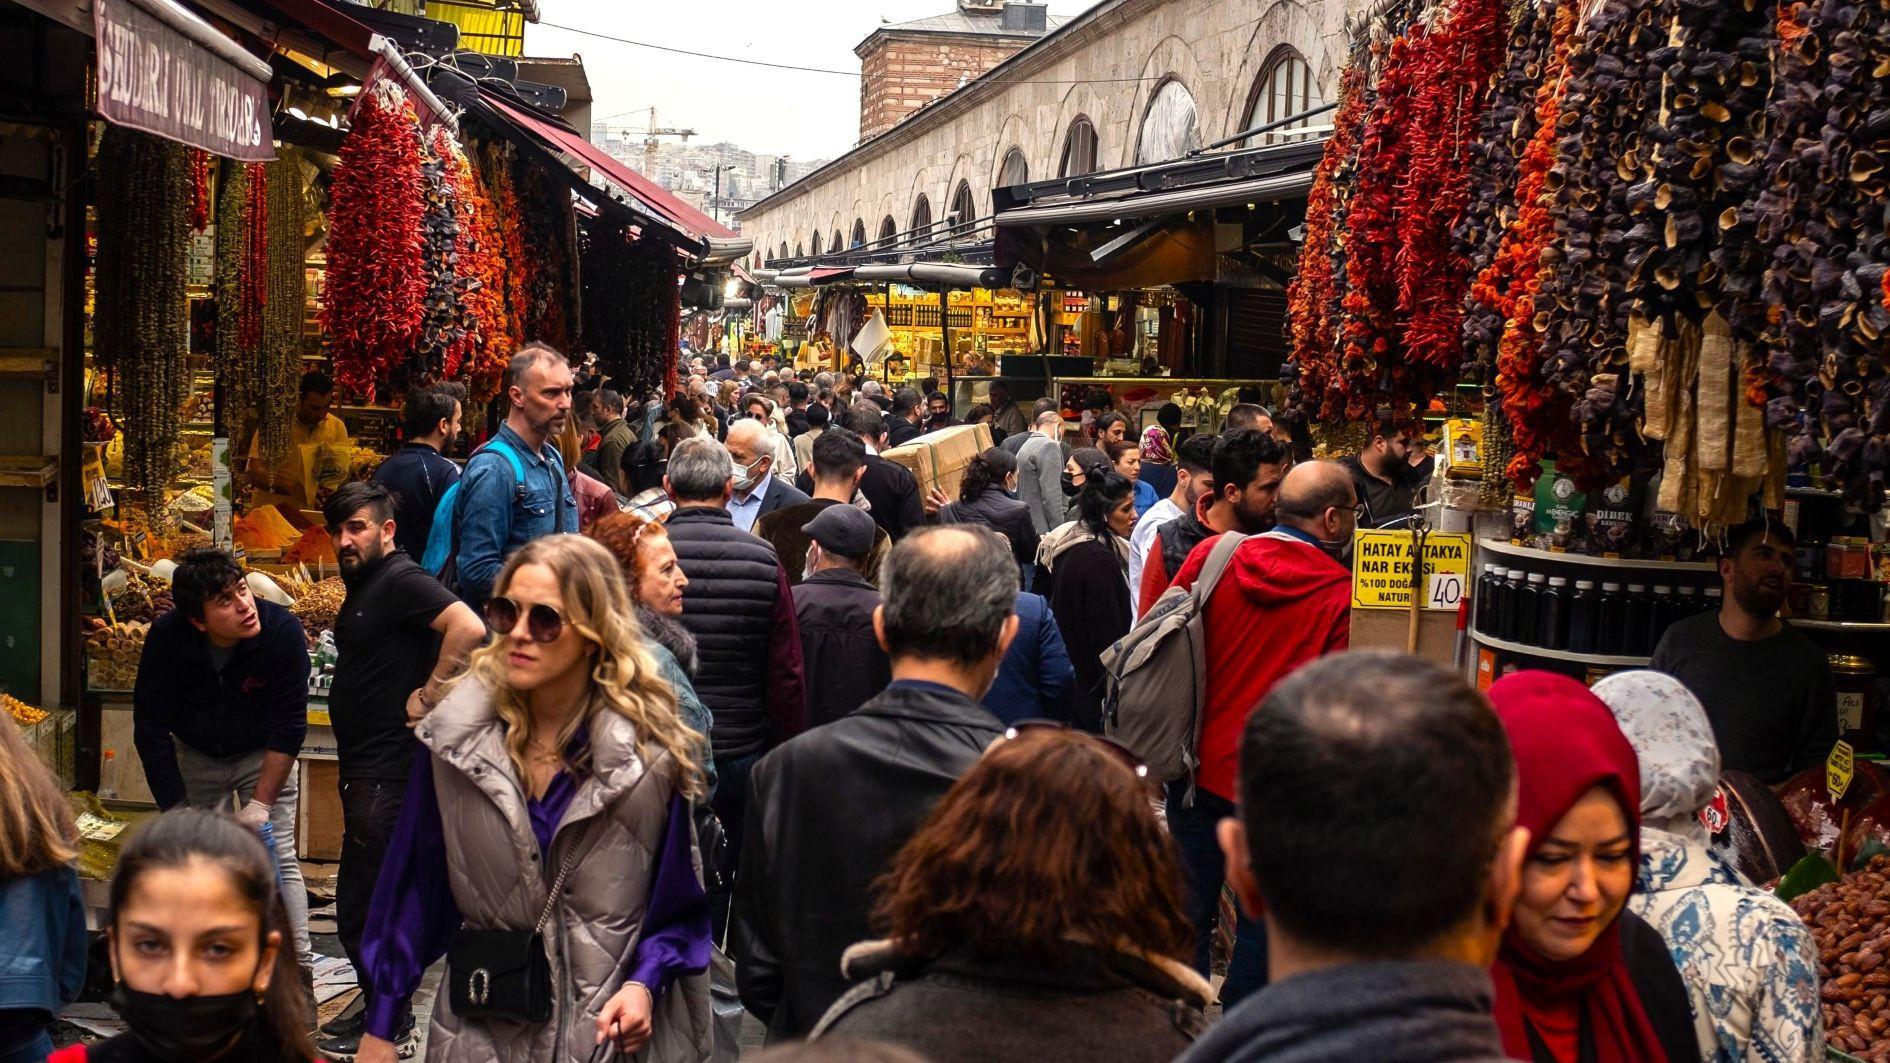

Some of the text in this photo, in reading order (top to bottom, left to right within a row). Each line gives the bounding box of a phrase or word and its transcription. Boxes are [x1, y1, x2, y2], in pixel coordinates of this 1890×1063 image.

[1363, 542, 1462, 559] HATAY ATAKYA
[1362, 561, 1388, 573] NAR
